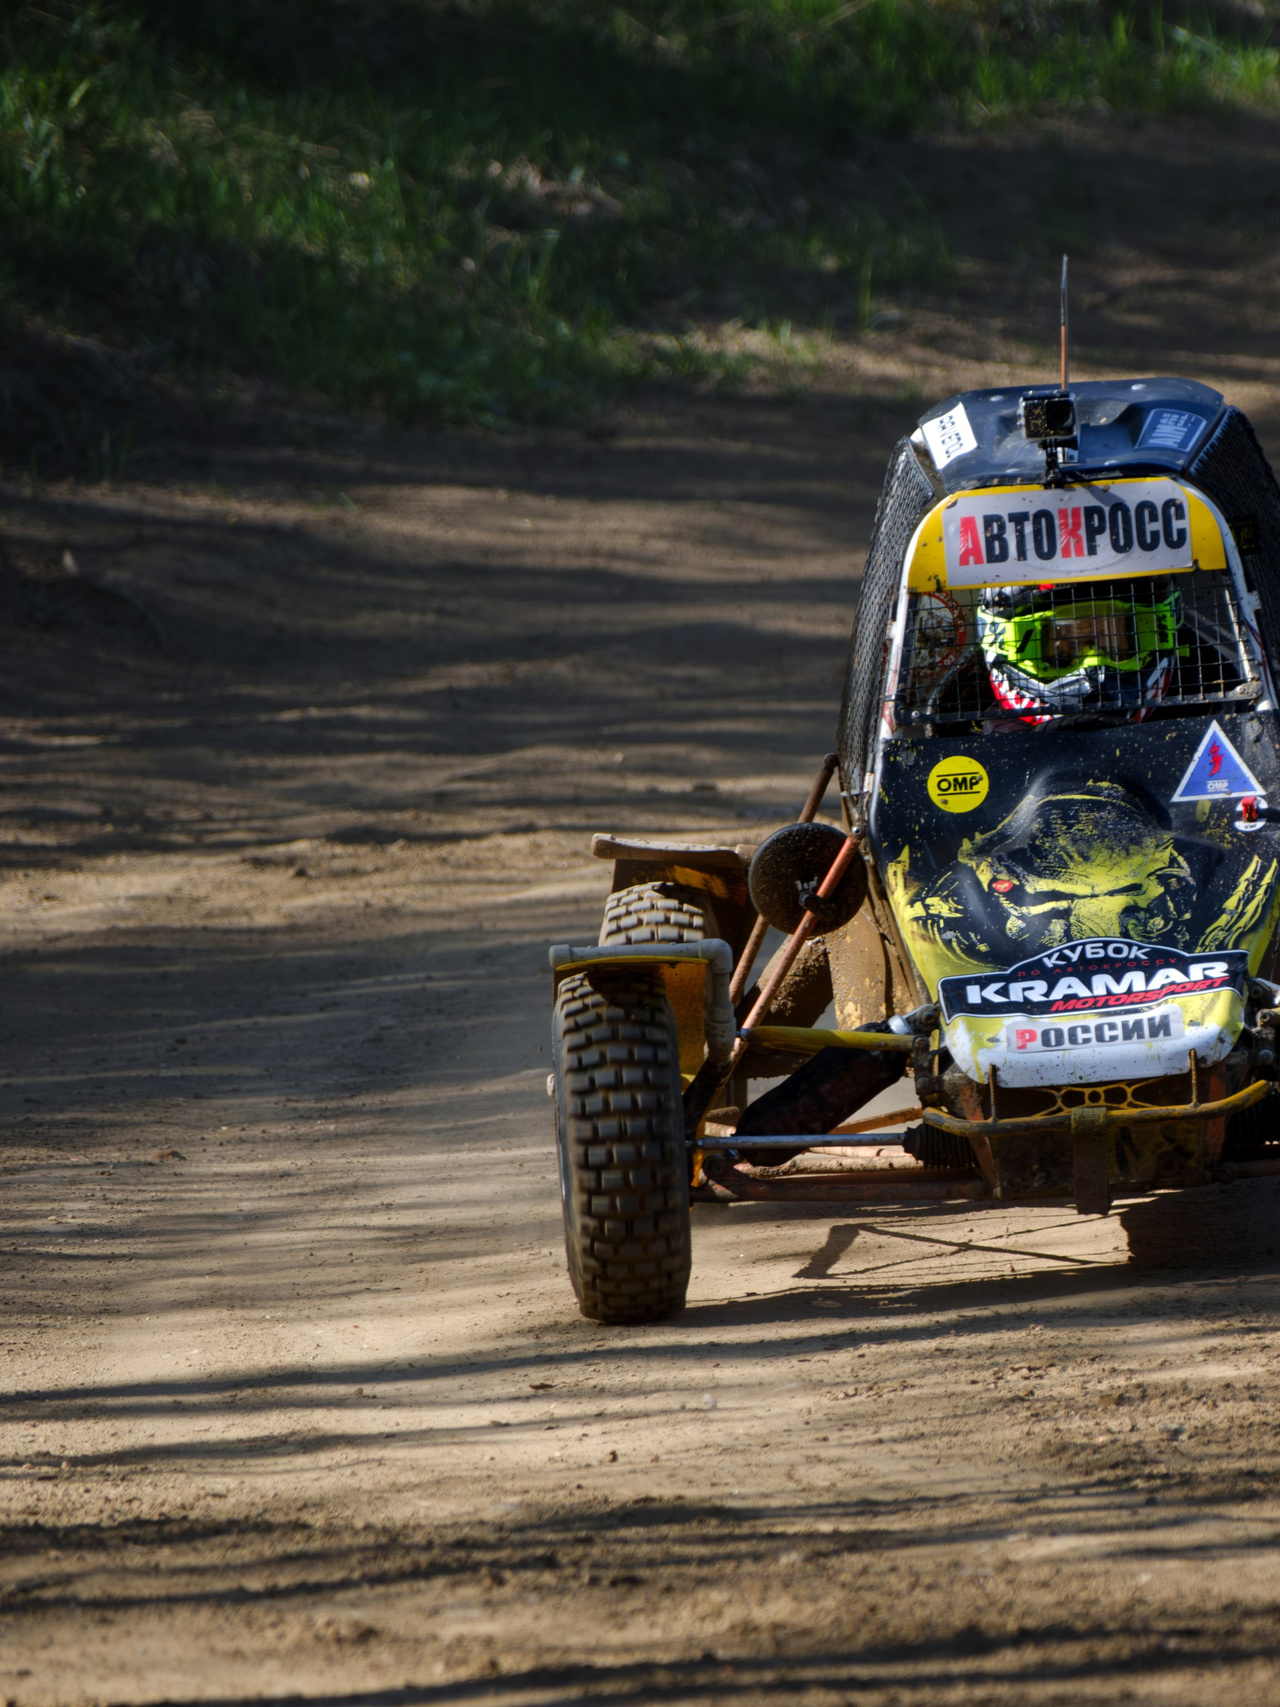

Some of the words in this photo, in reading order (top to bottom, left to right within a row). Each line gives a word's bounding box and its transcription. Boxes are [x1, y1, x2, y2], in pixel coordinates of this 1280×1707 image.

[959, 498, 1187, 566] АВТОКРОСС
[937, 776, 980, 793] OMP
[1207, 781, 1229, 792] OMP
[1017, 969, 1040, 978] ПО
[1054, 957, 1178, 974] АВТОКРОССУ
[1043, 943, 1151, 968] КУБОК
[966, 961, 1230, 1004] KRAMAR
[1050, 976, 1230, 1012] MOTORSPORT
[1015, 1014, 1172, 1050] РОССИИ
